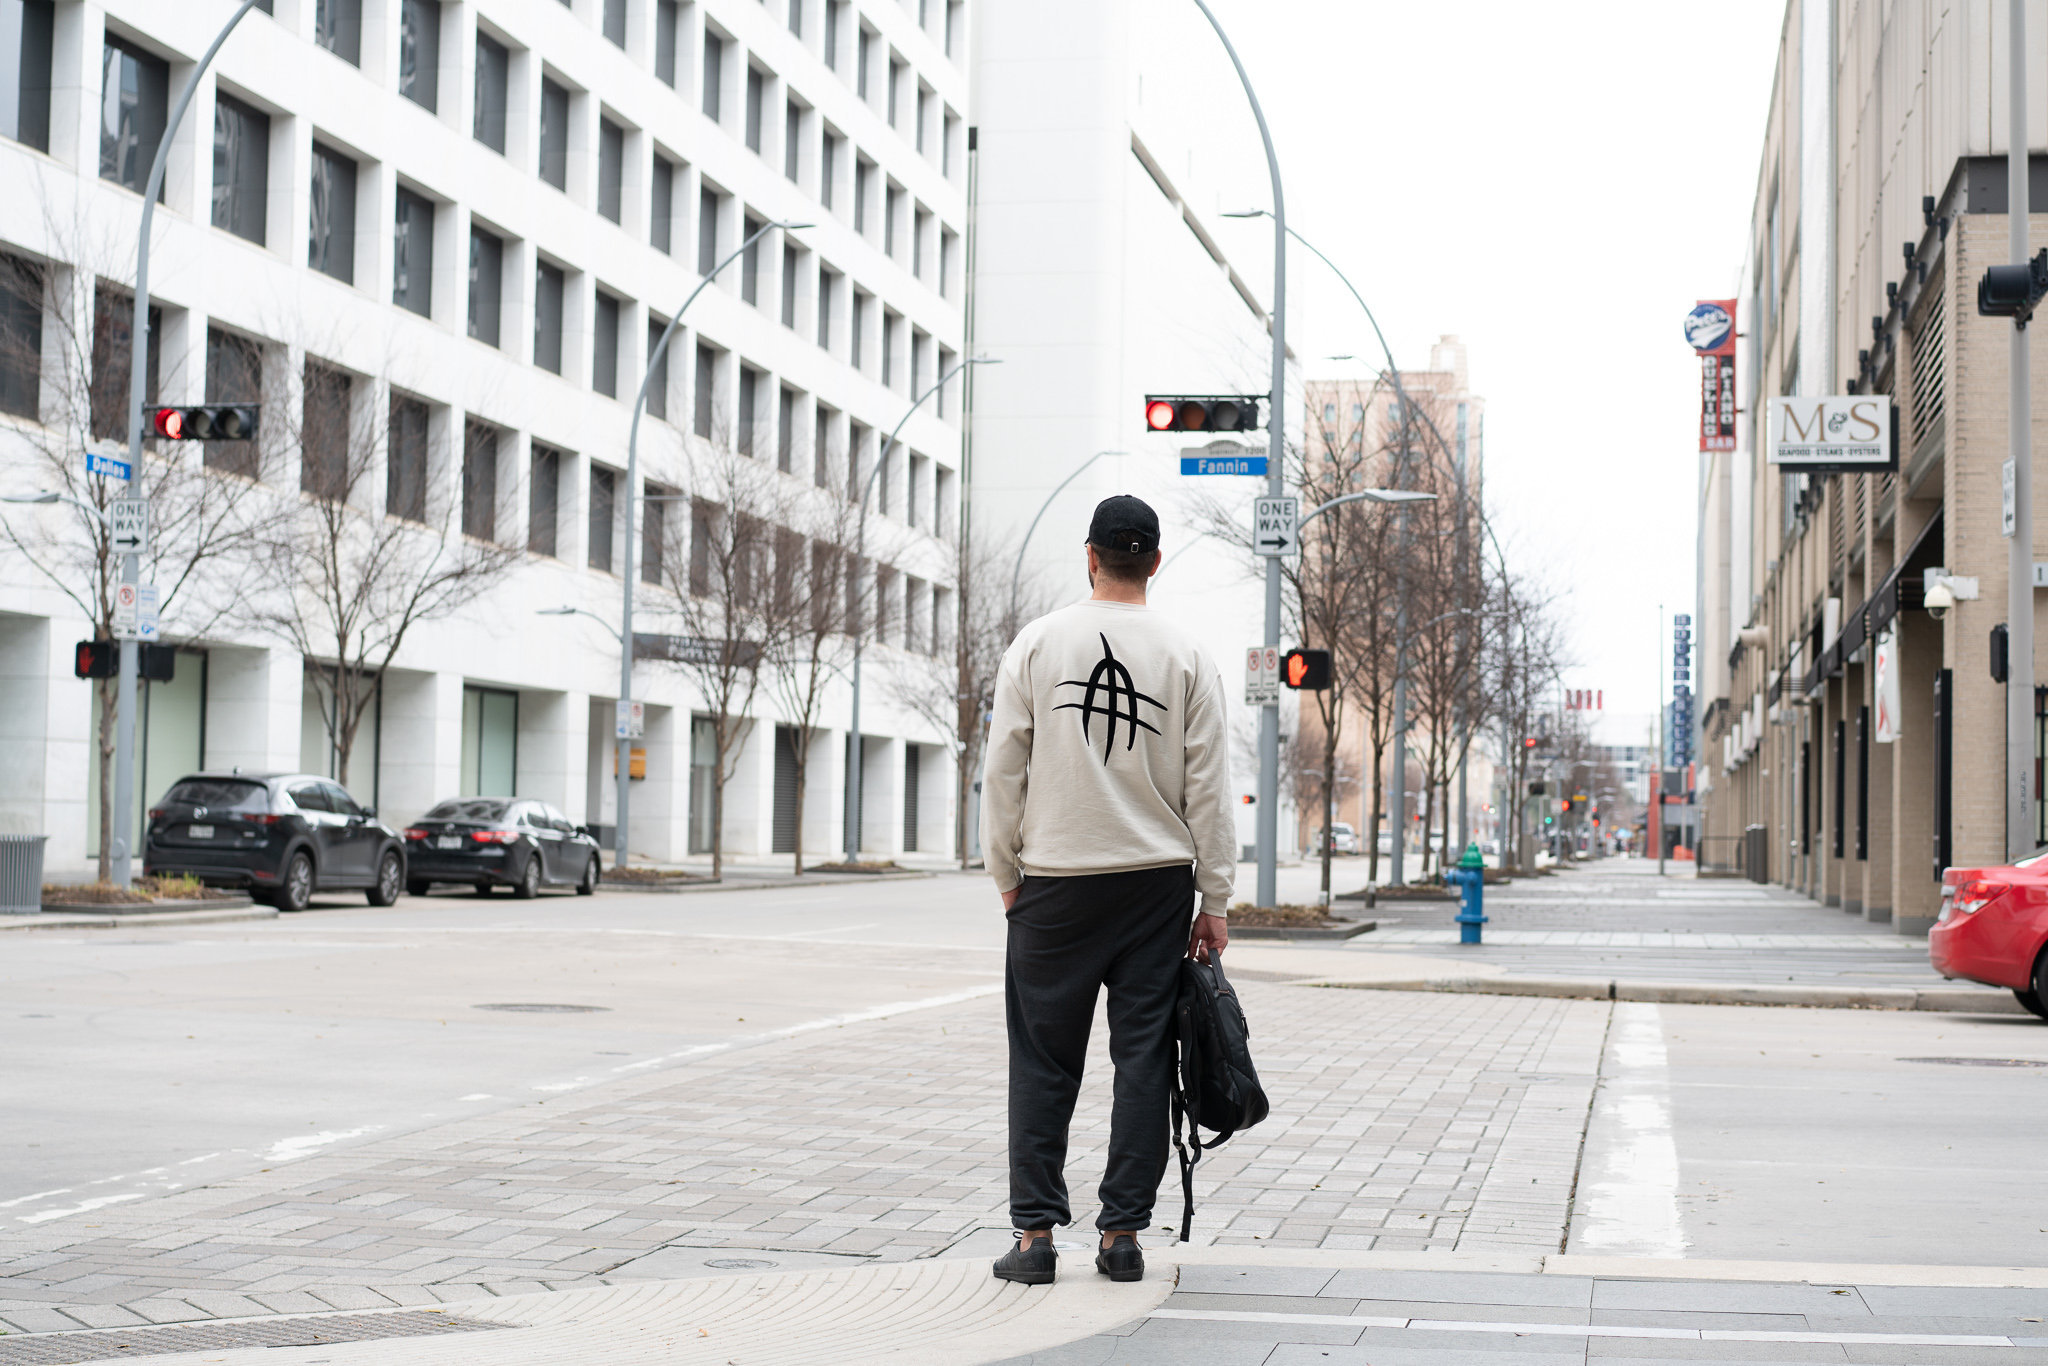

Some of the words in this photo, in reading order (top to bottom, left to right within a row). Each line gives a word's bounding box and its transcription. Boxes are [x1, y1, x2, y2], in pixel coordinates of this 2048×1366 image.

[1703, 356, 1717, 436] DUELING
[1720, 366, 1734, 425] PIANO
[1706, 437, 1734, 449] BAR
[1778, 448, 1810, 456] SEAFOOD
[1816, 448, 1843, 456] STEAKS
[1848, 448, 1880, 456] OYSTERS
[93, 456, 125, 478] Dallas
[1198, 459, 1249, 474] Fannin
[116, 503, 144, 516] ONE
[1260, 502, 1292, 516] ONE
[116, 519, 144, 530] WAY
[1259, 519, 1292, 531] WAY
